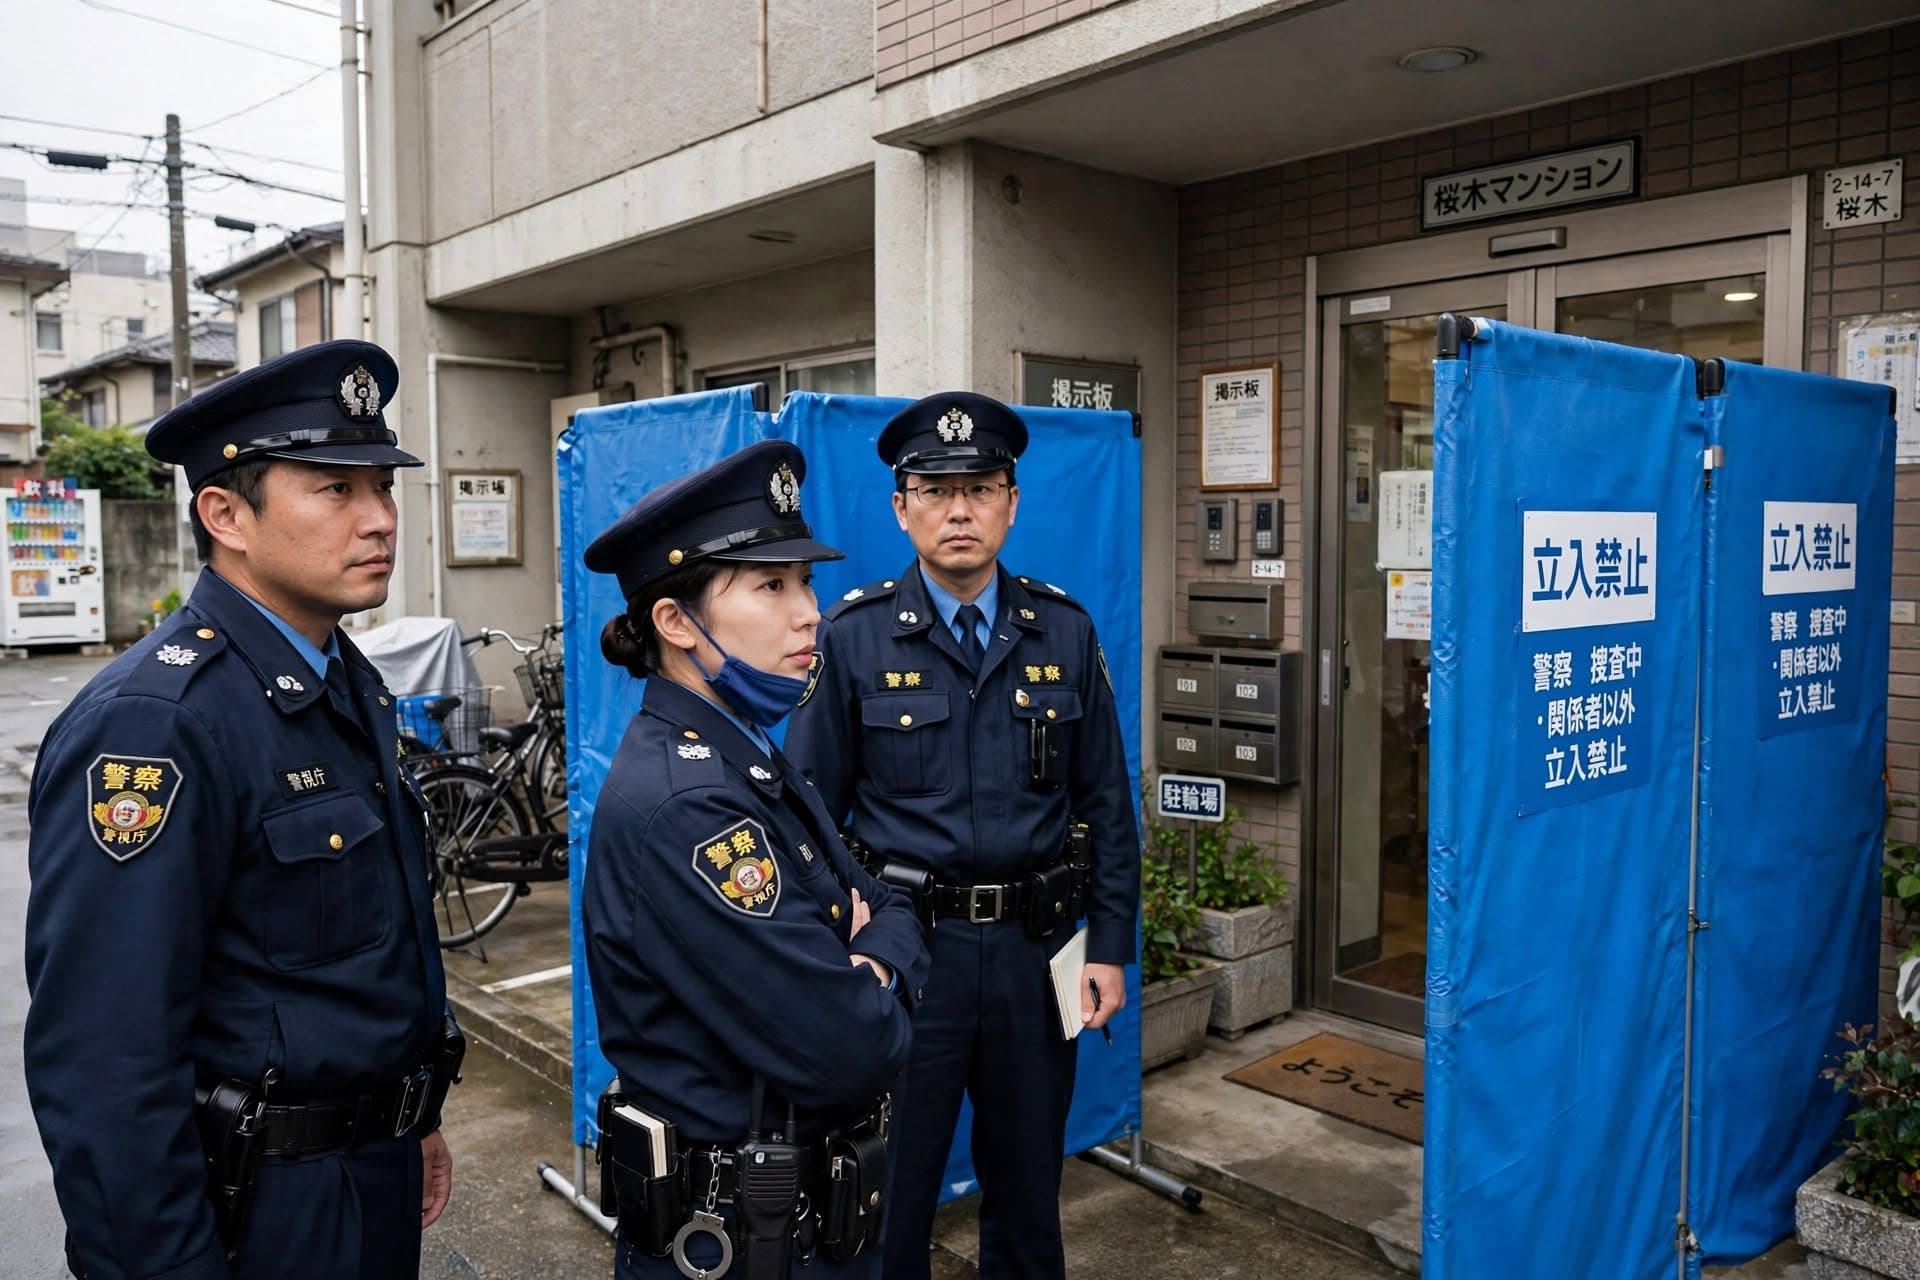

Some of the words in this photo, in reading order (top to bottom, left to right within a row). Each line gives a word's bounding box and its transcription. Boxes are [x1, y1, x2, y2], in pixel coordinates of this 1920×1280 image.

[1433, 157, 1624, 217] 桜木マンション
[1832, 168, 1894, 194] 2-14-7
[1836, 193, 1888, 221] 桜木
[1051, 377, 1113, 411] 掲示板
[1214, 379, 1261, 401] 掲示板
[1770, 522, 1851, 572] 立入禁止
[1532, 536, 1649, 601] 立入禁止
[1770, 610, 1798, 642] 警察
[1809, 605, 1846, 638] 捜査中
[1533, 650, 1573, 693] 警察
[1590, 641, 1642, 685] 捜査中
[1180, 680, 1194, 691] 101
[1239, 686, 1256, 698] 102
[1778, 679, 1836, 720] 立入禁止
[1179, 739, 1194, 752] 102
[1239, 747, 1256, 760] 103
[102, 762, 163, 791] 警察
[1544, 735, 1628, 789] 立入禁止
[286, 766, 326, 793] 警視庁
[1163, 783, 1218, 813] 駐輪場
[705, 829, 757, 871] 警察
